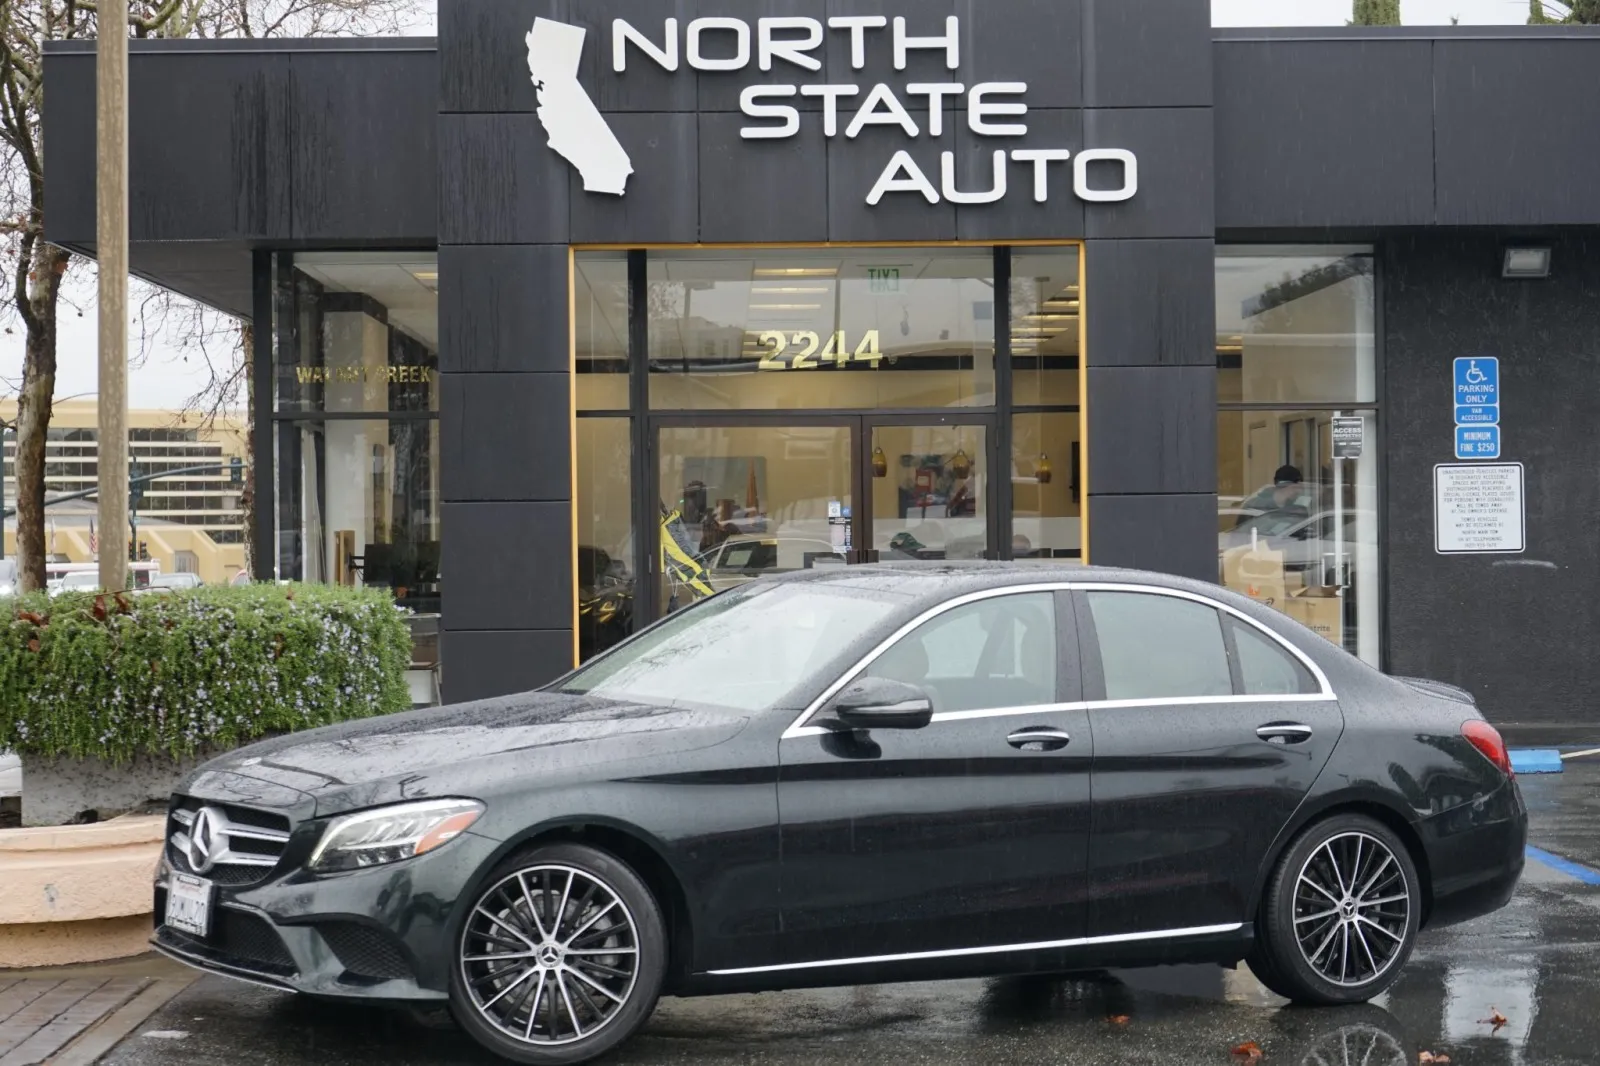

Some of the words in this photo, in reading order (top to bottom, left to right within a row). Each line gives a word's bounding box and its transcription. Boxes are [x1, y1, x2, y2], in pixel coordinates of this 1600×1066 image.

[612, 16, 959, 72] NORTH
[739, 82, 1028, 139] STATE
[865, 148, 1138, 205] AUTO
[757, 329, 883, 369] 2244
[1458, 384, 1495, 393] PARKING
[1465, 394, 1488, 404] ONLY
[1460, 443, 1474, 453] FINE
[1477, 442, 1495, 453] $250
[1463, 431, 1491, 441] MINIMUM
